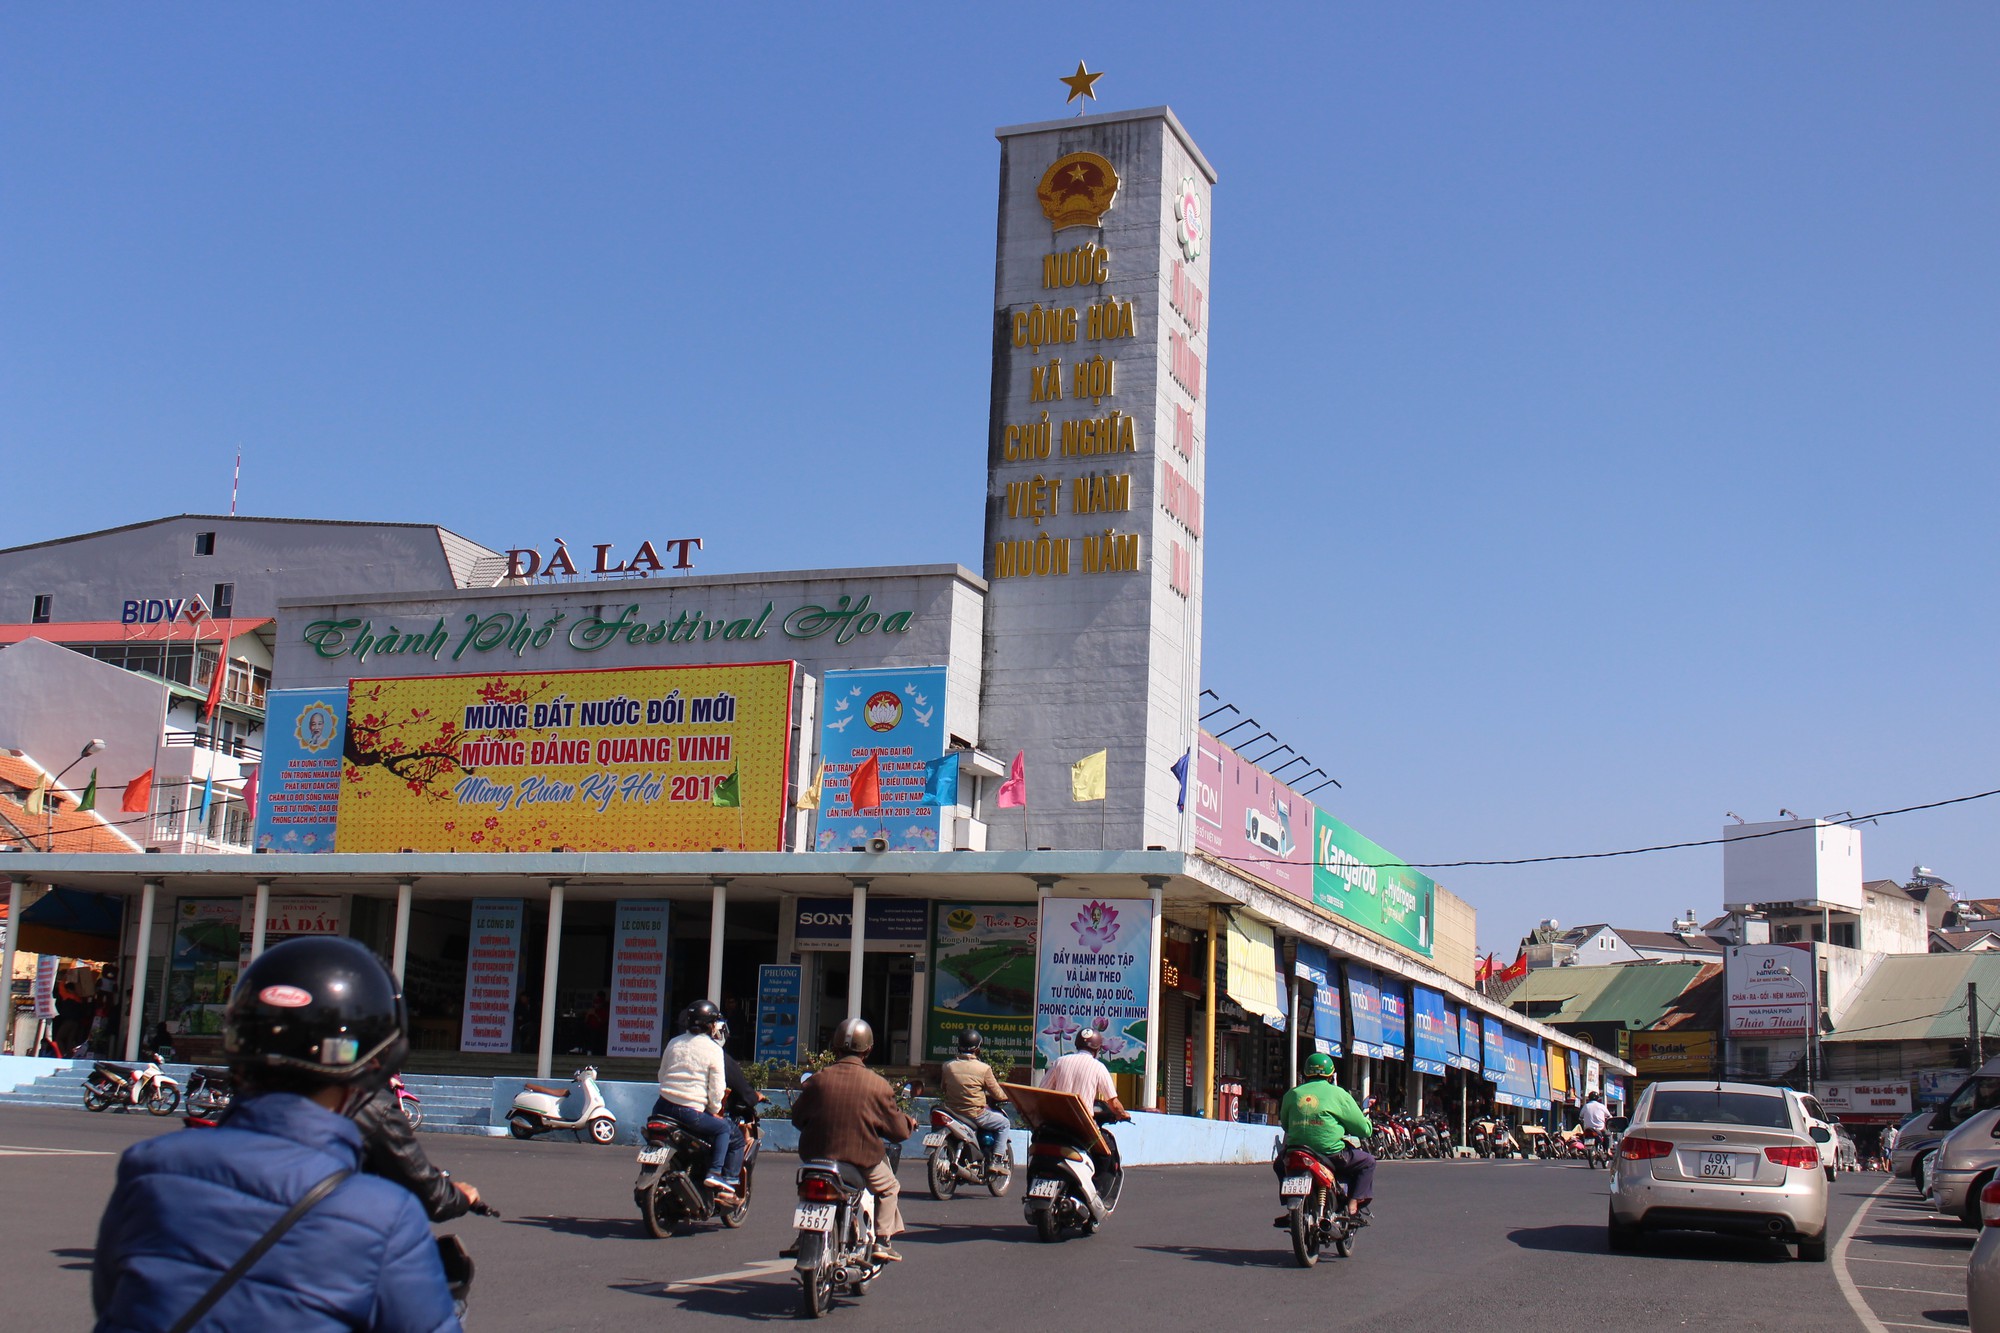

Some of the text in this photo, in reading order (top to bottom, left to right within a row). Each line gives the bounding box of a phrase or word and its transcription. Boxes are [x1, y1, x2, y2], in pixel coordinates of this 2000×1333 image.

[1043, 241, 1110, 289] NƯỚC
[1012, 295, 1136, 355] CỘNG HÒA
[1031, 355, 1115, 406] XÃ HỘI
[1004, 410, 1137, 462] CHỦ NGHĨA
[1007, 473, 1131, 526] VIỆT NAM
[503, 537, 703, 579] ĐÀ LẠT
[994, 528, 1140, 579] MUÔN NĂM
[121, 599, 185, 624] BIDV
[303, 594, 914, 664] Thành Phố Festival Hoa
[464, 689, 736, 730] MỪNG ĐẤT NƯỚC ĐỔI MỚI
[460, 733, 731, 768] MỪNG ĐẢNG QUANG VINH
[896, 762, 911, 771] NAM
[300, 782, 312, 790] HUY
[454, 775, 515, 812] Mừng
[516, 774, 576, 808] Xuân
[580, 774, 617, 813] Kỷ
[621, 772, 666, 806] Hợi
[272, 816, 292, 824] PHONG
[894, 807, 910, 816] 2019
[915, 807, 931, 816] 2024
[1324, 829, 1377, 896] Kangaroo
[1388, 875, 1416, 914] Hydrogen
[298, 911, 339, 931] ĐẤT
[1053, 948, 1134, 970] ĐẨY MẠNH HỌC TẬP
[1066, 967, 1121, 983] VÀ LÀM THEO
[1051, 986, 1063, 998] TƯ
[1096, 987, 1114, 1004] ĐẠO
[1115, 986, 1135, 1003] ĐỨC,
[1038, 1003, 1067, 1016] PHONG
[1068, 1001, 1092, 1017] CÁCH
[1107, 1003, 1123, 1018] CHÍ
[1124, 1007, 1147, 1019] MINH
[1651, 1043, 1687, 1053] Kodak
[1704, 1164, 1732, 1177] 8741
[1707, 1153, 1729, 1165] 49X
[799, 1215, 828, 1230] 2567
